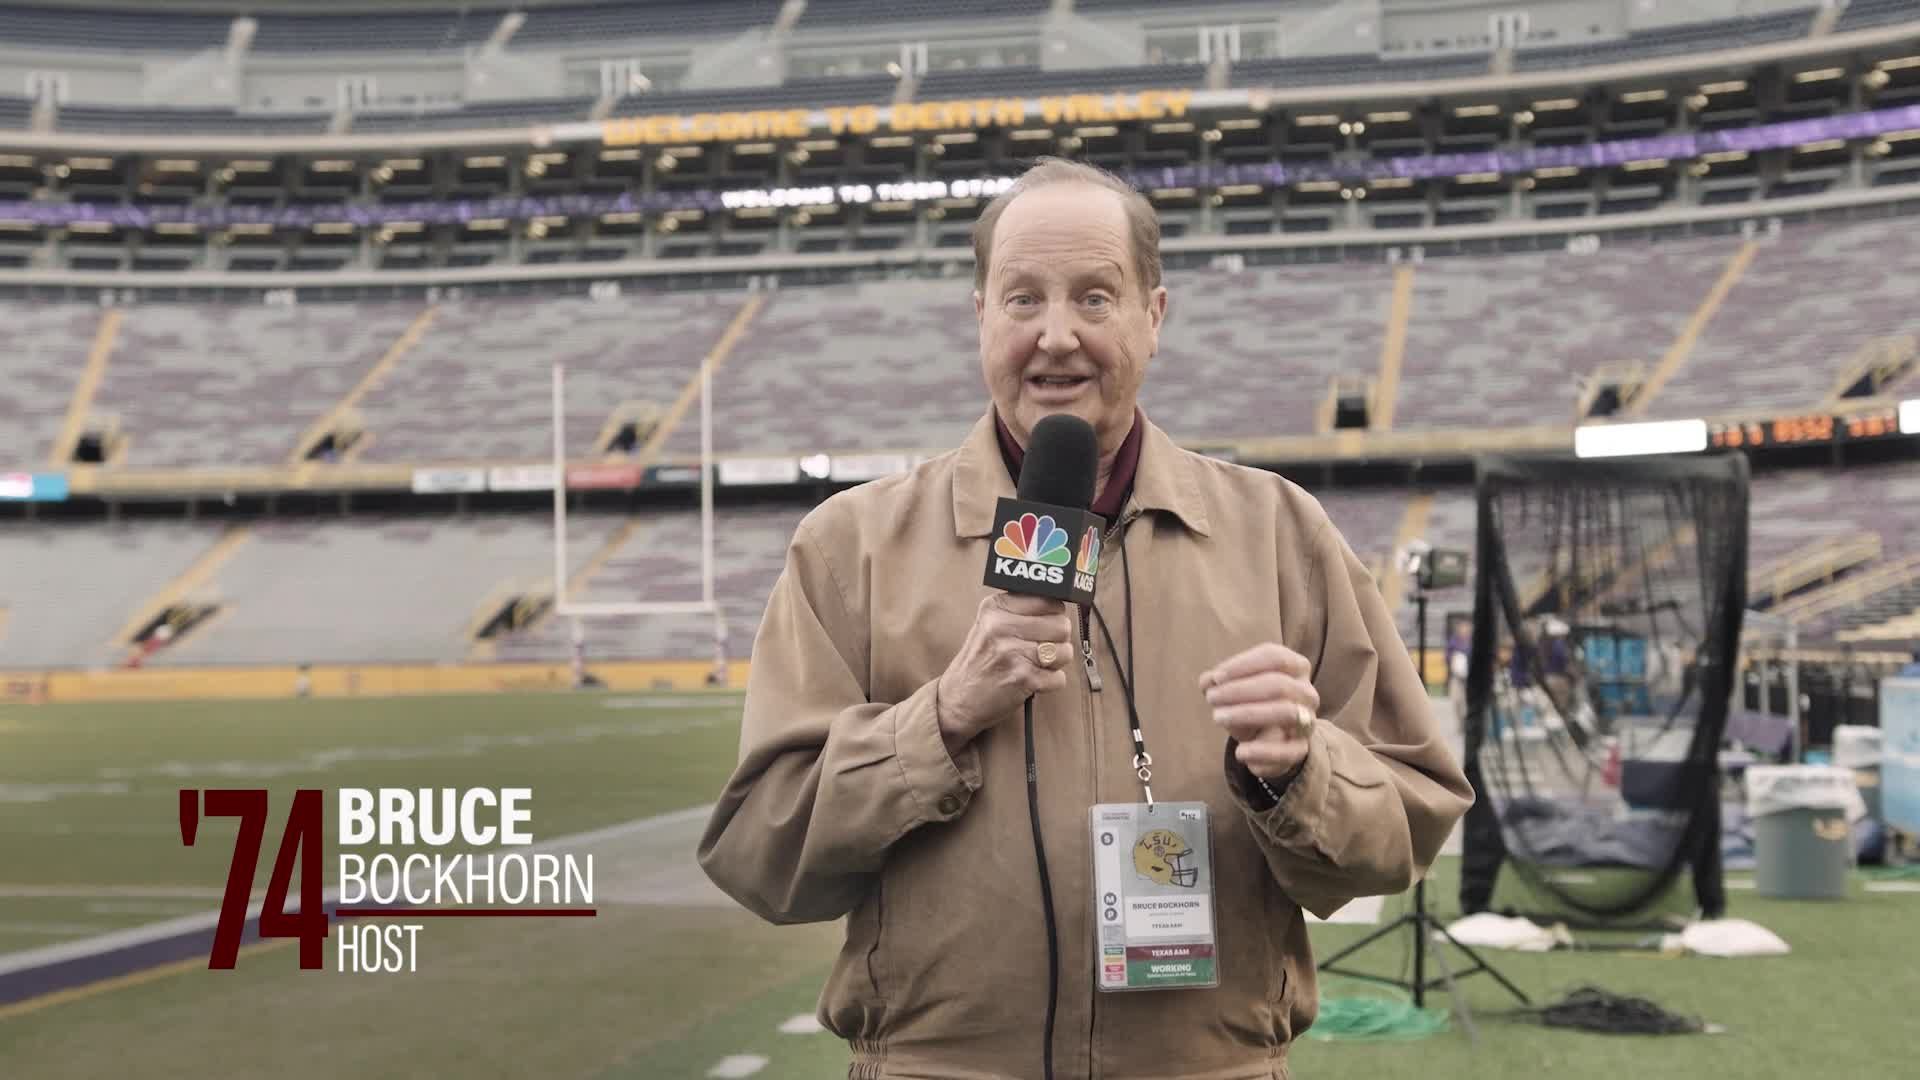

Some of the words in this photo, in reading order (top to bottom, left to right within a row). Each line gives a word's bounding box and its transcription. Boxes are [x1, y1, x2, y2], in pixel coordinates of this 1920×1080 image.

[601, 108, 812, 145] WELCOME
[830, 104, 877, 134] TO
[891, 97, 1024, 131] DEATH
[1040, 89, 1191, 122] VALLEY
[721, 186, 834, 208] WELCOME
[839, 184, 872, 203] TO
[995, 558, 1064, 584] KAGS
[1073, 571, 1095, 592] KAGS
[1132, 902, 1157, 910] BRUCE
[1158, 901, 1200, 909] BOCKHORN
[1152, 949, 1173, 957] TEXAS
[1151, 963, 1192, 973] WORKING
